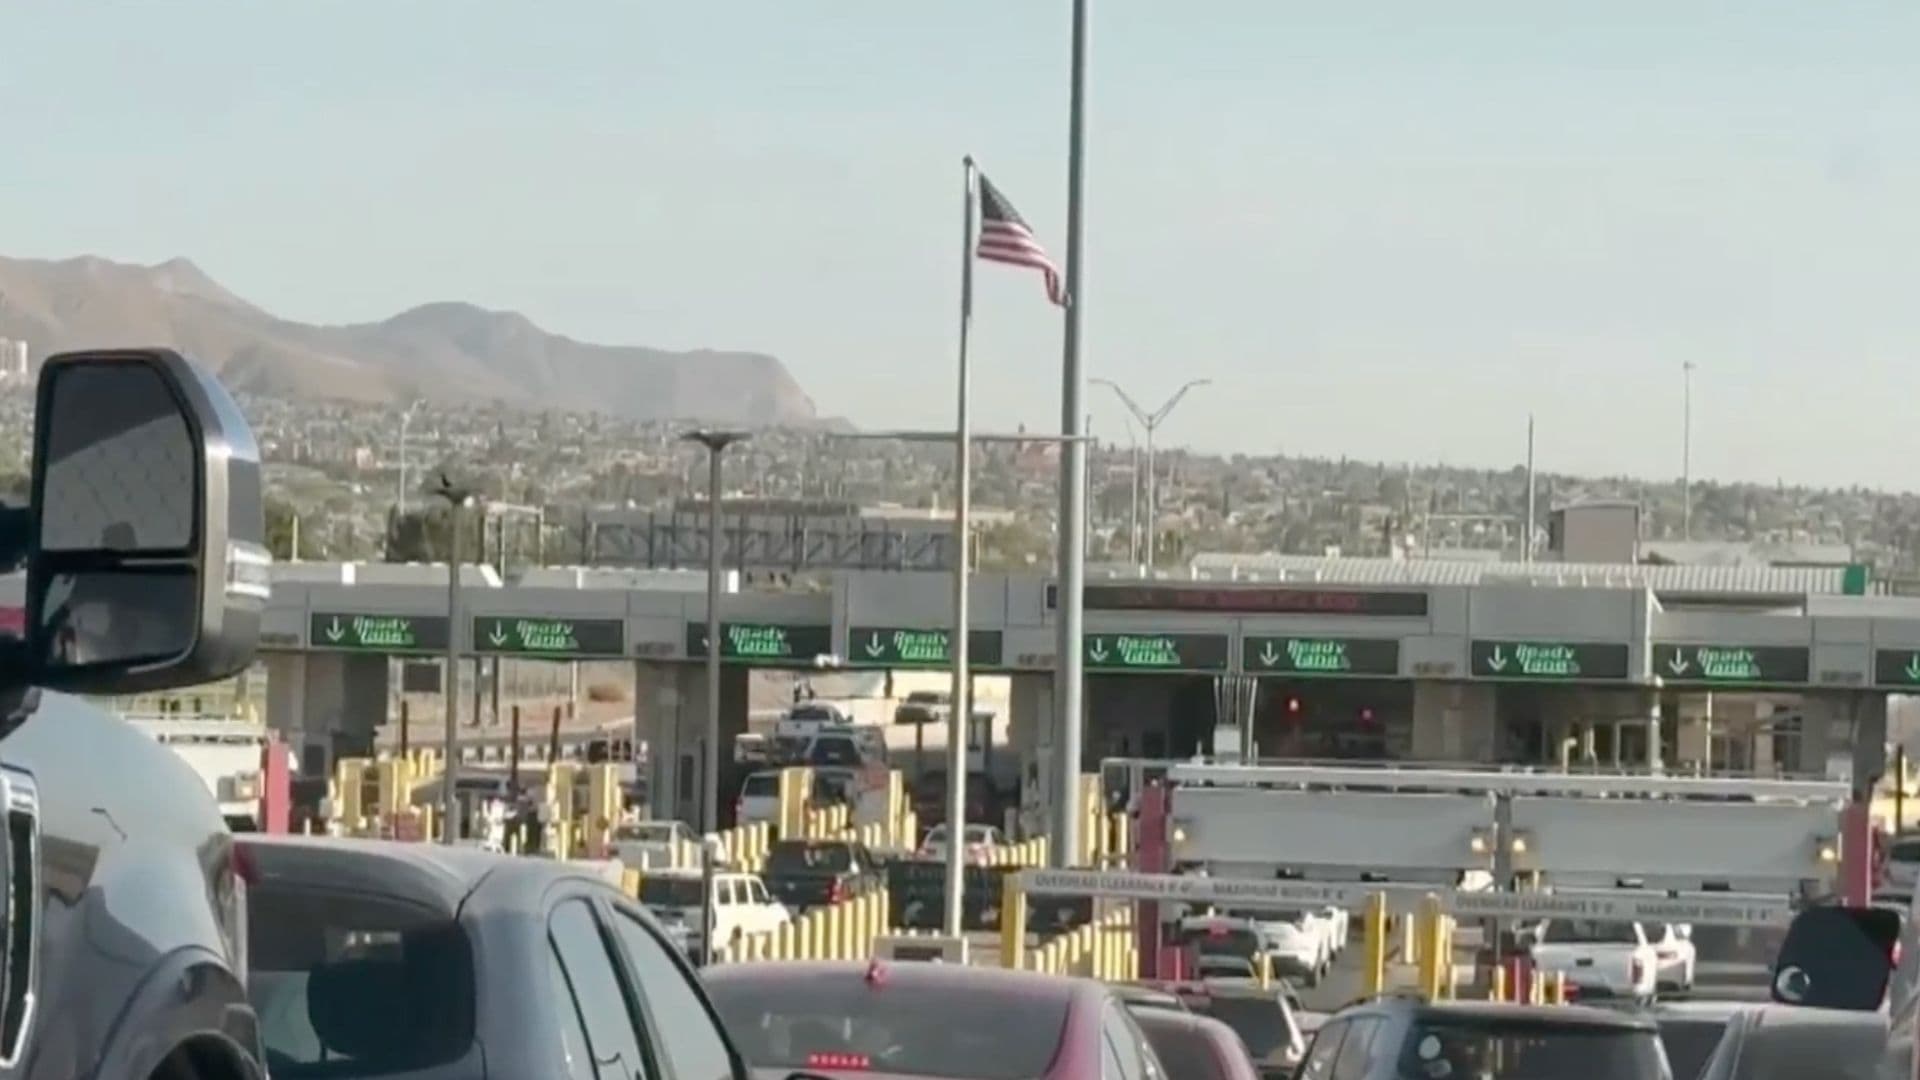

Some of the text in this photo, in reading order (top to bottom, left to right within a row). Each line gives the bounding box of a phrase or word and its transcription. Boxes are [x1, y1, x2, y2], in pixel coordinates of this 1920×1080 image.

[354, 616, 410, 633] Ready
[517, 620, 573, 637] Ready
[729, 625, 787, 642] Ready
[894, 631, 948, 648] Ready
[1117, 636, 1176, 653] Ready
[1287, 640, 1346, 657] Ready
[1516, 644, 1575, 662] Ready
[1697, 648, 1754, 665] Ready
